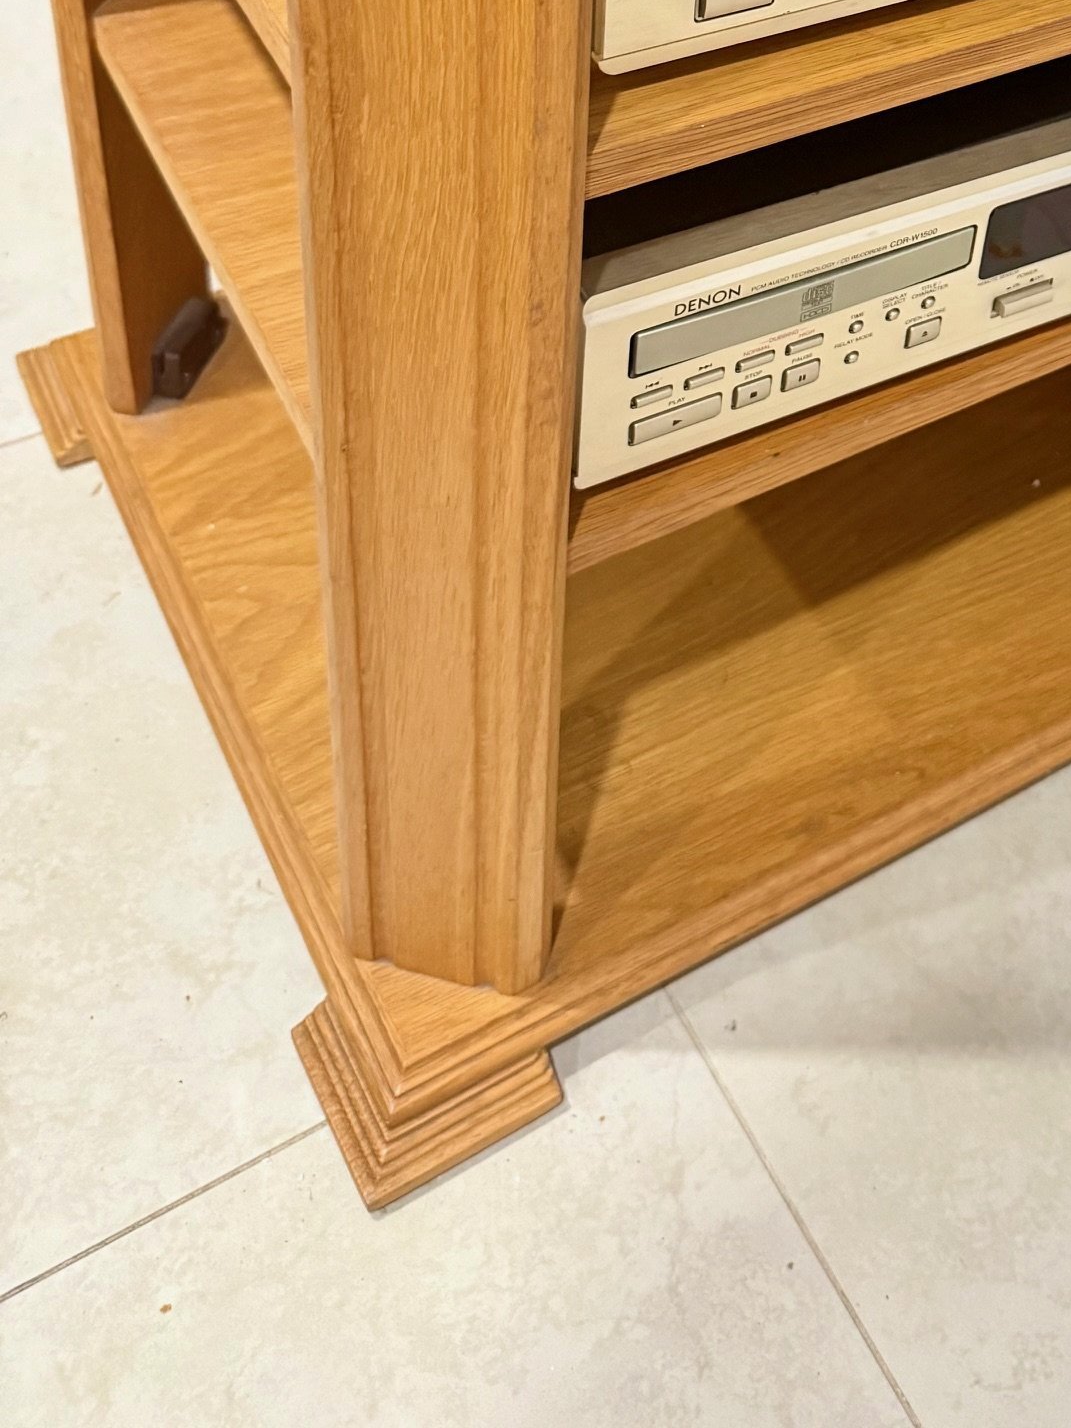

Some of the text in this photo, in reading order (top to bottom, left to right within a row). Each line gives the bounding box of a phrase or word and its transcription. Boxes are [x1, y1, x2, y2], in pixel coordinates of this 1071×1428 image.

[674, 284, 742, 317] DENON
[768, 275, 790, 287] AUDIO
[791, 260, 836, 279] TECHNOLOGY
[851, 246, 888, 261] RECORDER
[889, 227, 938, 248] CDR-W1500
[668, 396, 686, 406] PLAY
